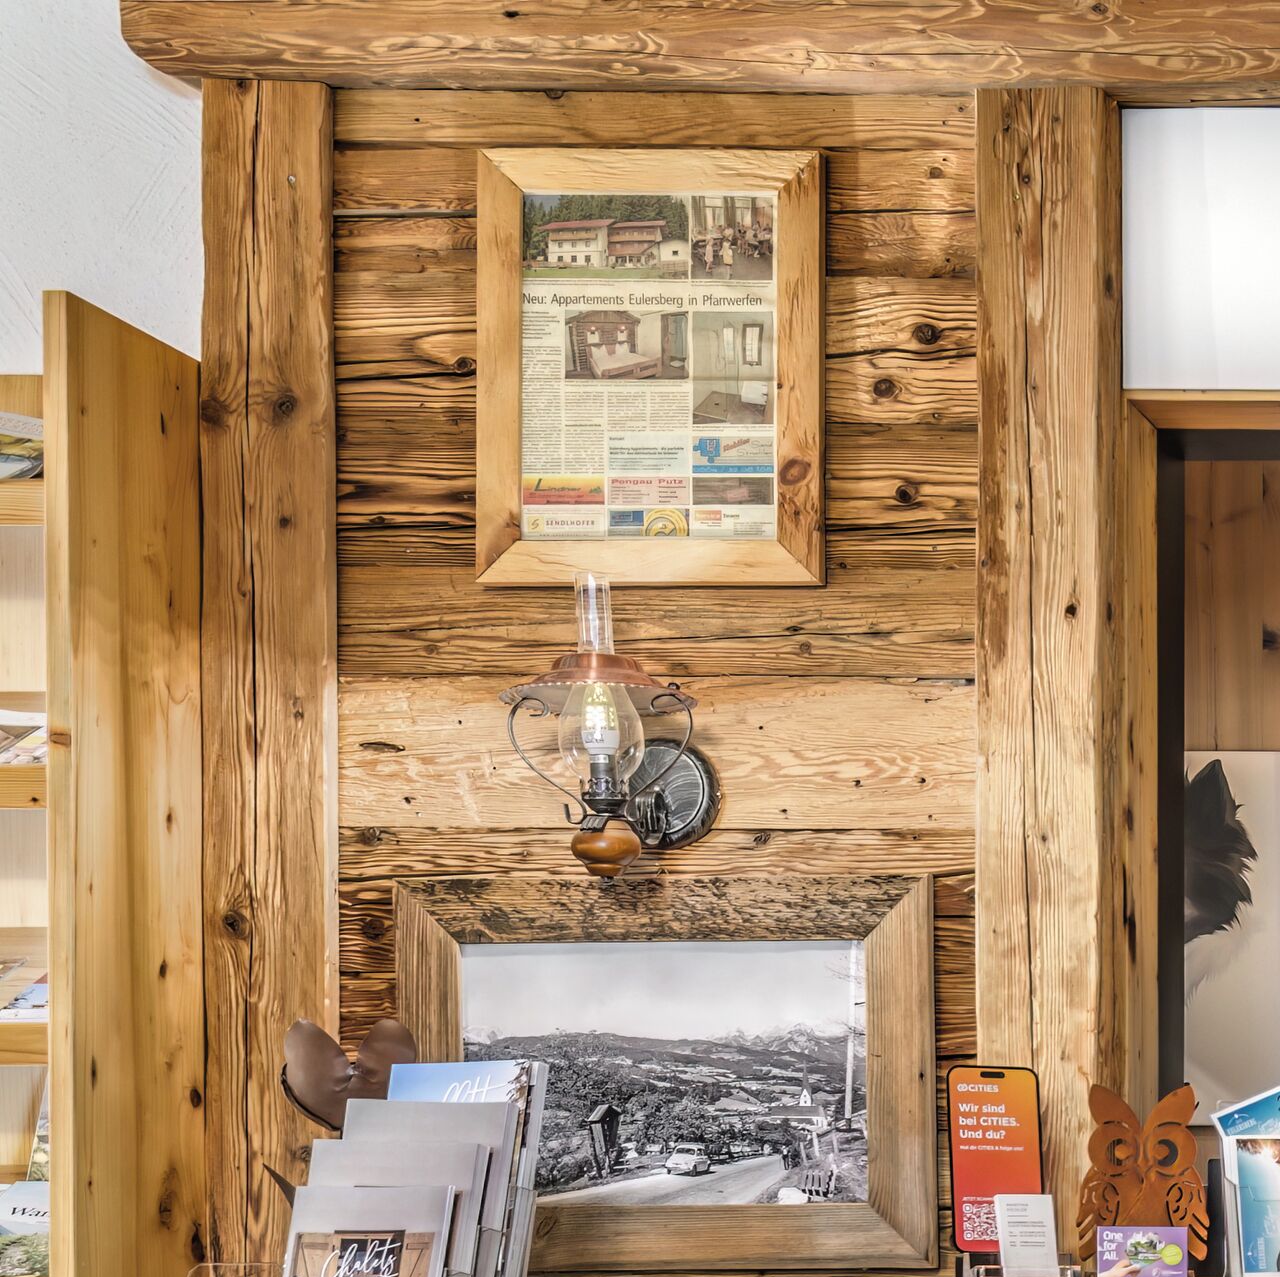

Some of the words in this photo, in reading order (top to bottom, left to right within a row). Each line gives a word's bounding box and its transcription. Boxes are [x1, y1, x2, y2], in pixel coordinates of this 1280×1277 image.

[522, 293, 547, 304] Neu:
[551, 293, 625, 308] Appartements
[629, 293, 684, 308] Eulersberg
[688, 294, 698, 305] in
[702, 293, 762, 306] Pfarrwerfen
[968, 1084, 999, 1093] CITIES
[958, 1103, 979, 1113] Wir
[982, 1103, 1006, 1113] sind
[959, 1116, 977, 1126] bei
[980, 1116, 1020, 1127] CITIES.
[959, 1129, 982, 1139] Und
[985, 1130, 1006, 1140] du?
[1103, 1231, 1123, 1240] One
[1103, 1241, 1118, 1250] for
